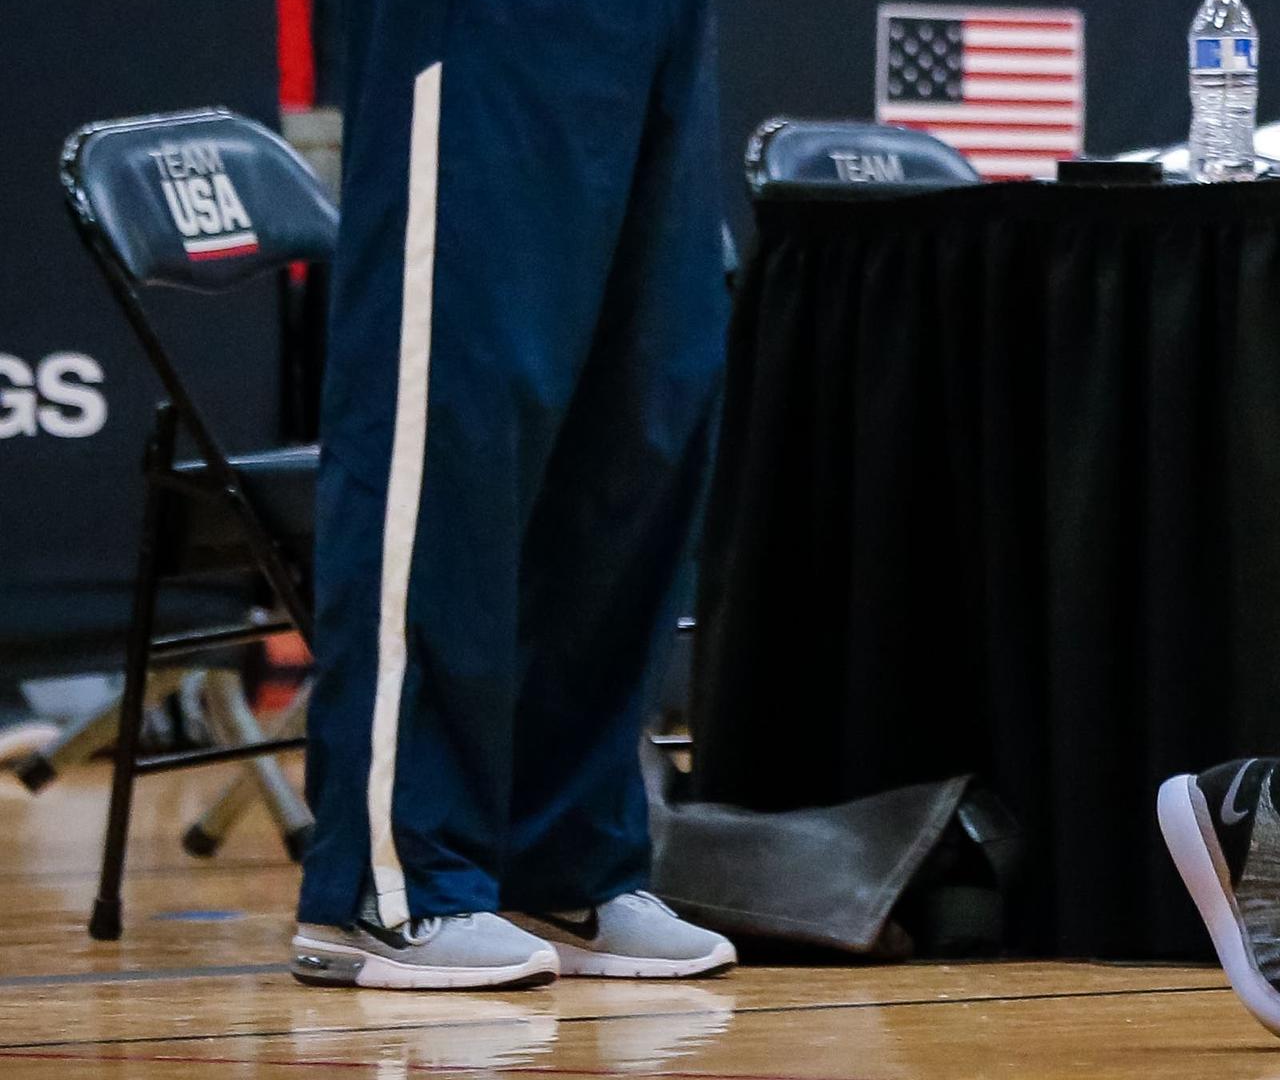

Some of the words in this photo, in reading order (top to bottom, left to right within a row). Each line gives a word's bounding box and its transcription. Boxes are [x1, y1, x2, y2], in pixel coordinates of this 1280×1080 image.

[149, 141, 224, 179] TEAM
[830, 152, 905, 183] TEAM
[161, 173, 253, 237] USA
